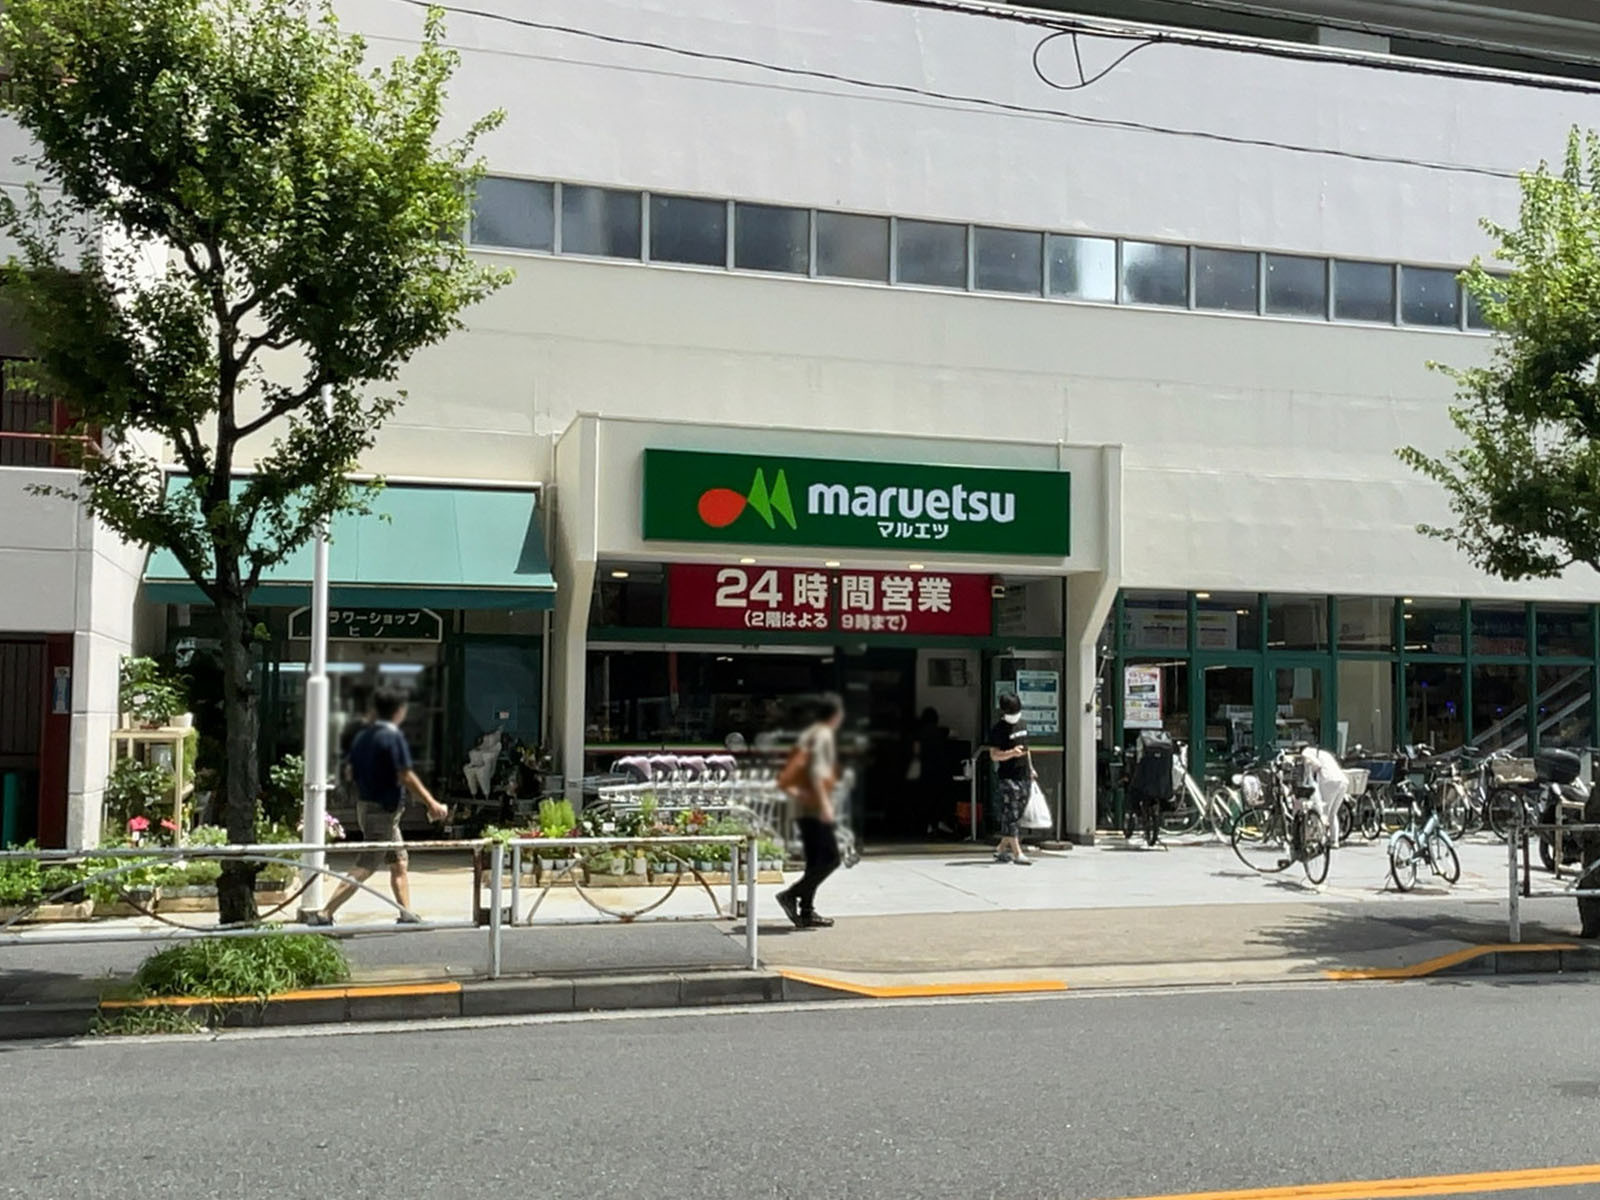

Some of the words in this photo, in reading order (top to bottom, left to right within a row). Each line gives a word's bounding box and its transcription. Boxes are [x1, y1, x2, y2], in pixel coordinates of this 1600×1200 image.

[808, 483, 1015, 523] maruetsu
[877, 521, 949, 539] マルエツ
[715, 568, 952, 612] 24時間営業
[328, 611, 420, 625] ラワーショップ
